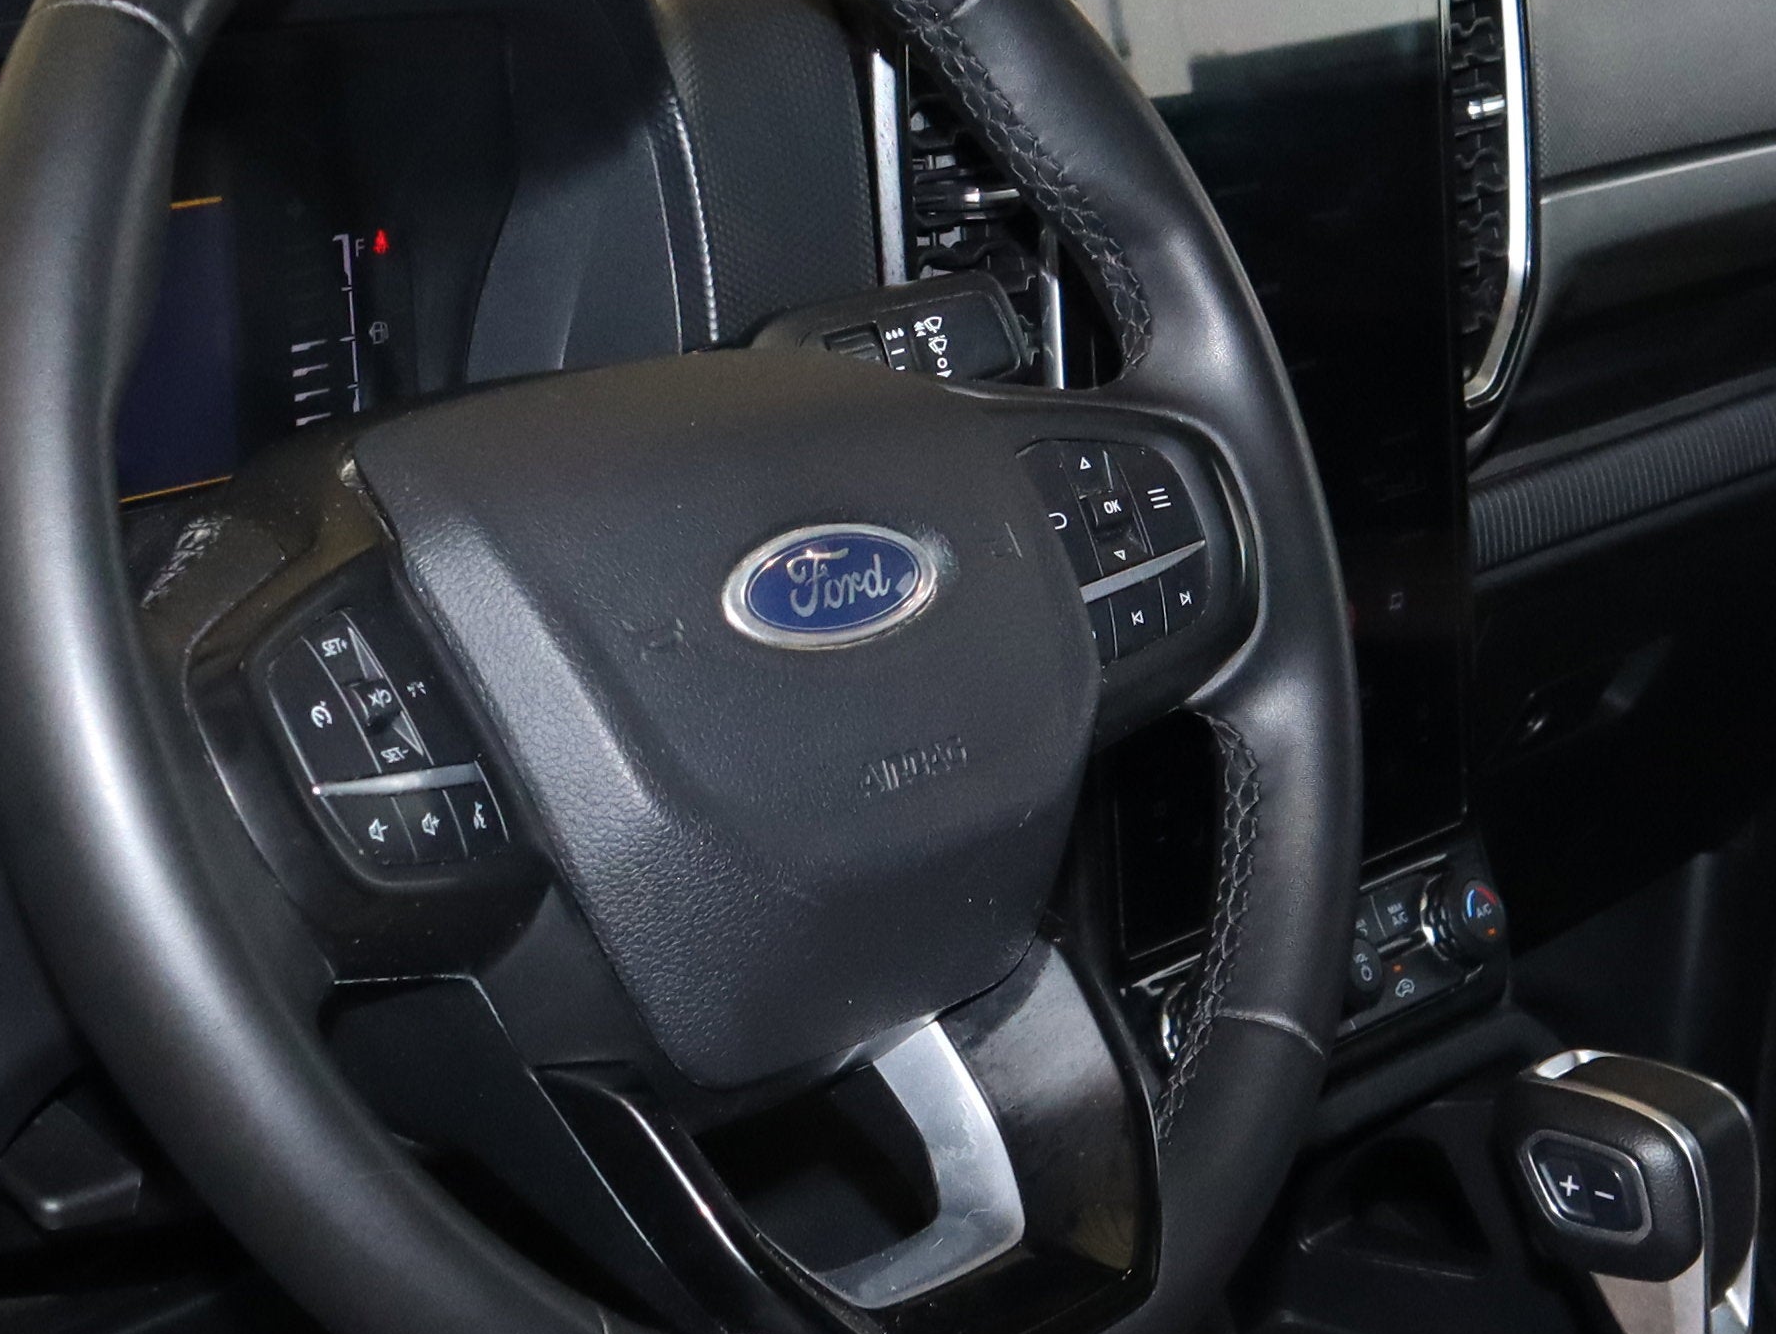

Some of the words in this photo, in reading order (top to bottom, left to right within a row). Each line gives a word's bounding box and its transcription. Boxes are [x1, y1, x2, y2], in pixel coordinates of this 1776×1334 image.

[355, 237, 366, 258] F
[1103, 498, 1122, 515] OK
[785, 547, 892, 618] Ford
[321, 636, 348, 658] SET+
[380, 747, 410, 764] SET-
[859, 735, 968, 797] AIRBAG
[1391, 911, 1409, 925] A/C
[1475, 902, 1493, 918] A/C
